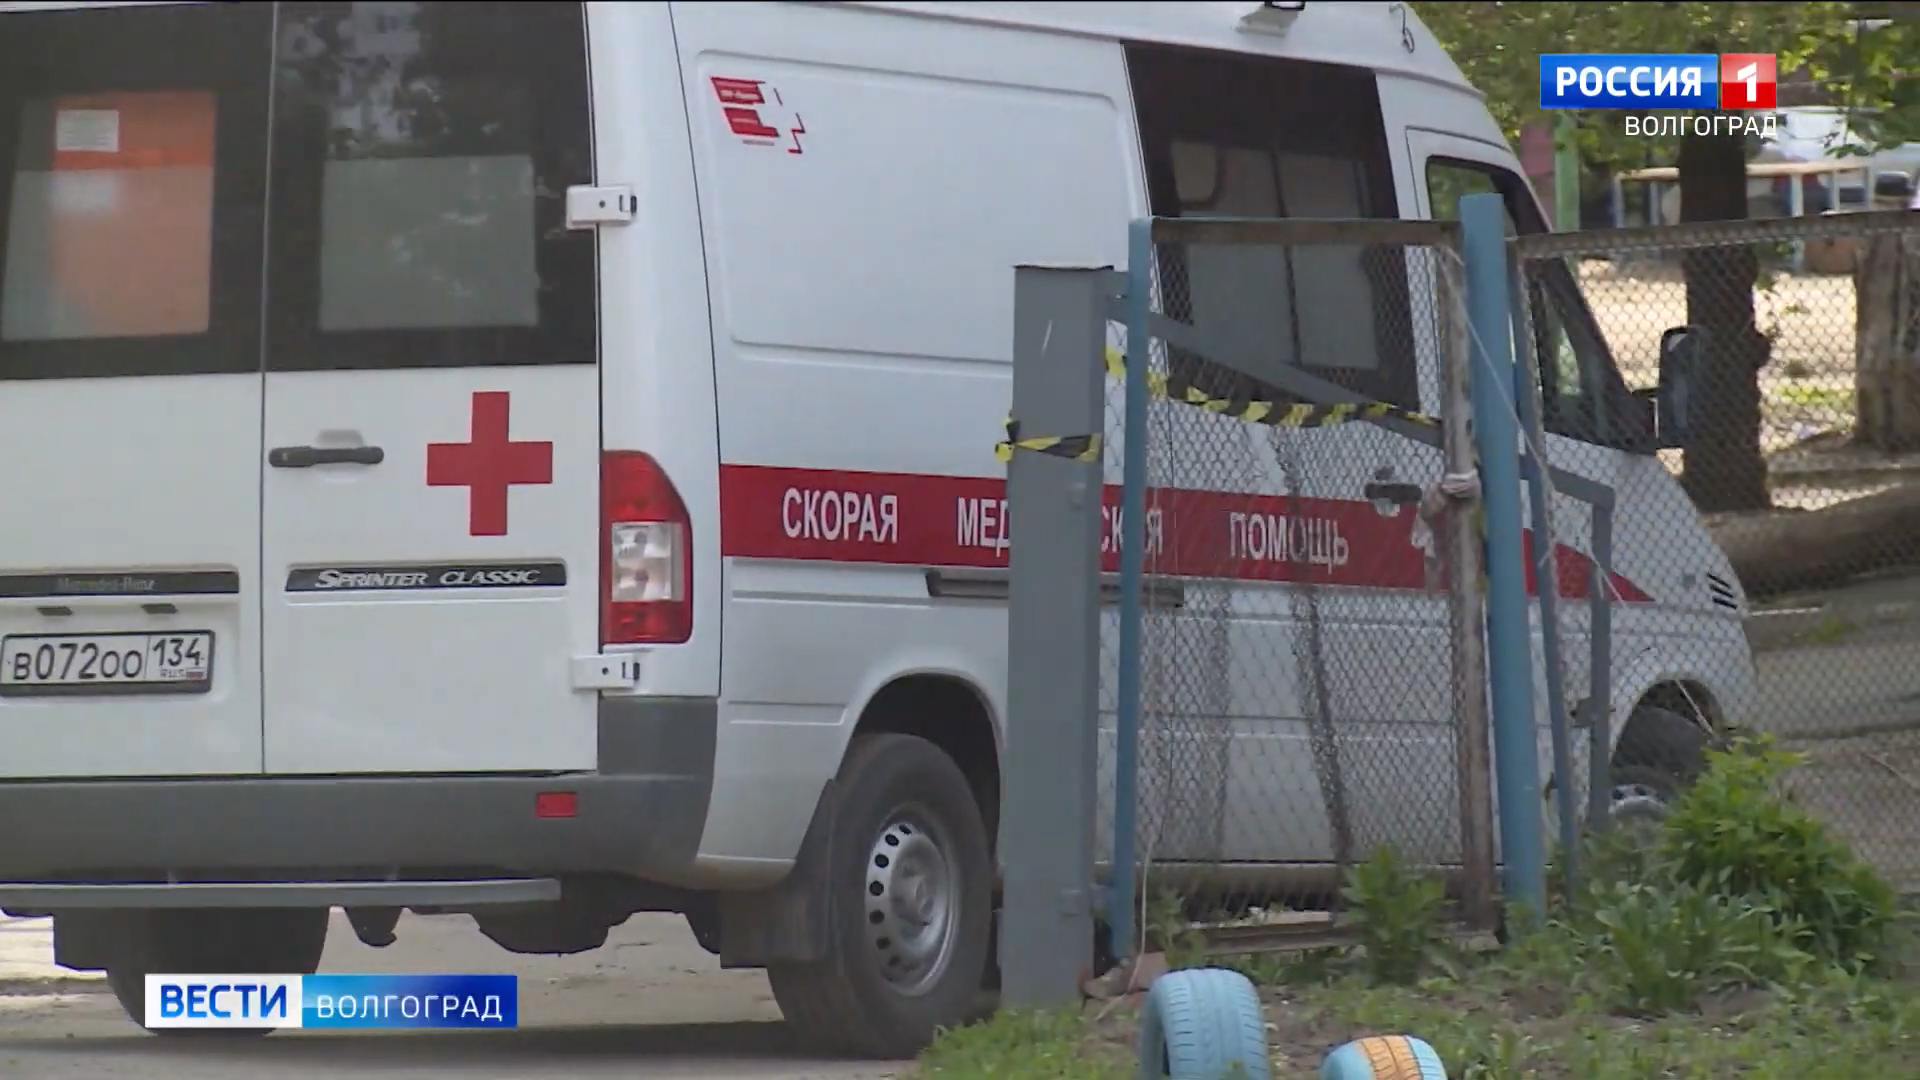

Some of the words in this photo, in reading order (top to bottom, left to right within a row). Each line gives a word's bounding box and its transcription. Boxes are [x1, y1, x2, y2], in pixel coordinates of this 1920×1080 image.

[782, 487, 898, 544] СКОРАЯ
[1229, 511, 1349, 574] ПОМОЩЬ
[439, 569, 541, 585] CLASSIC
[152, 638, 201, 667] 134
